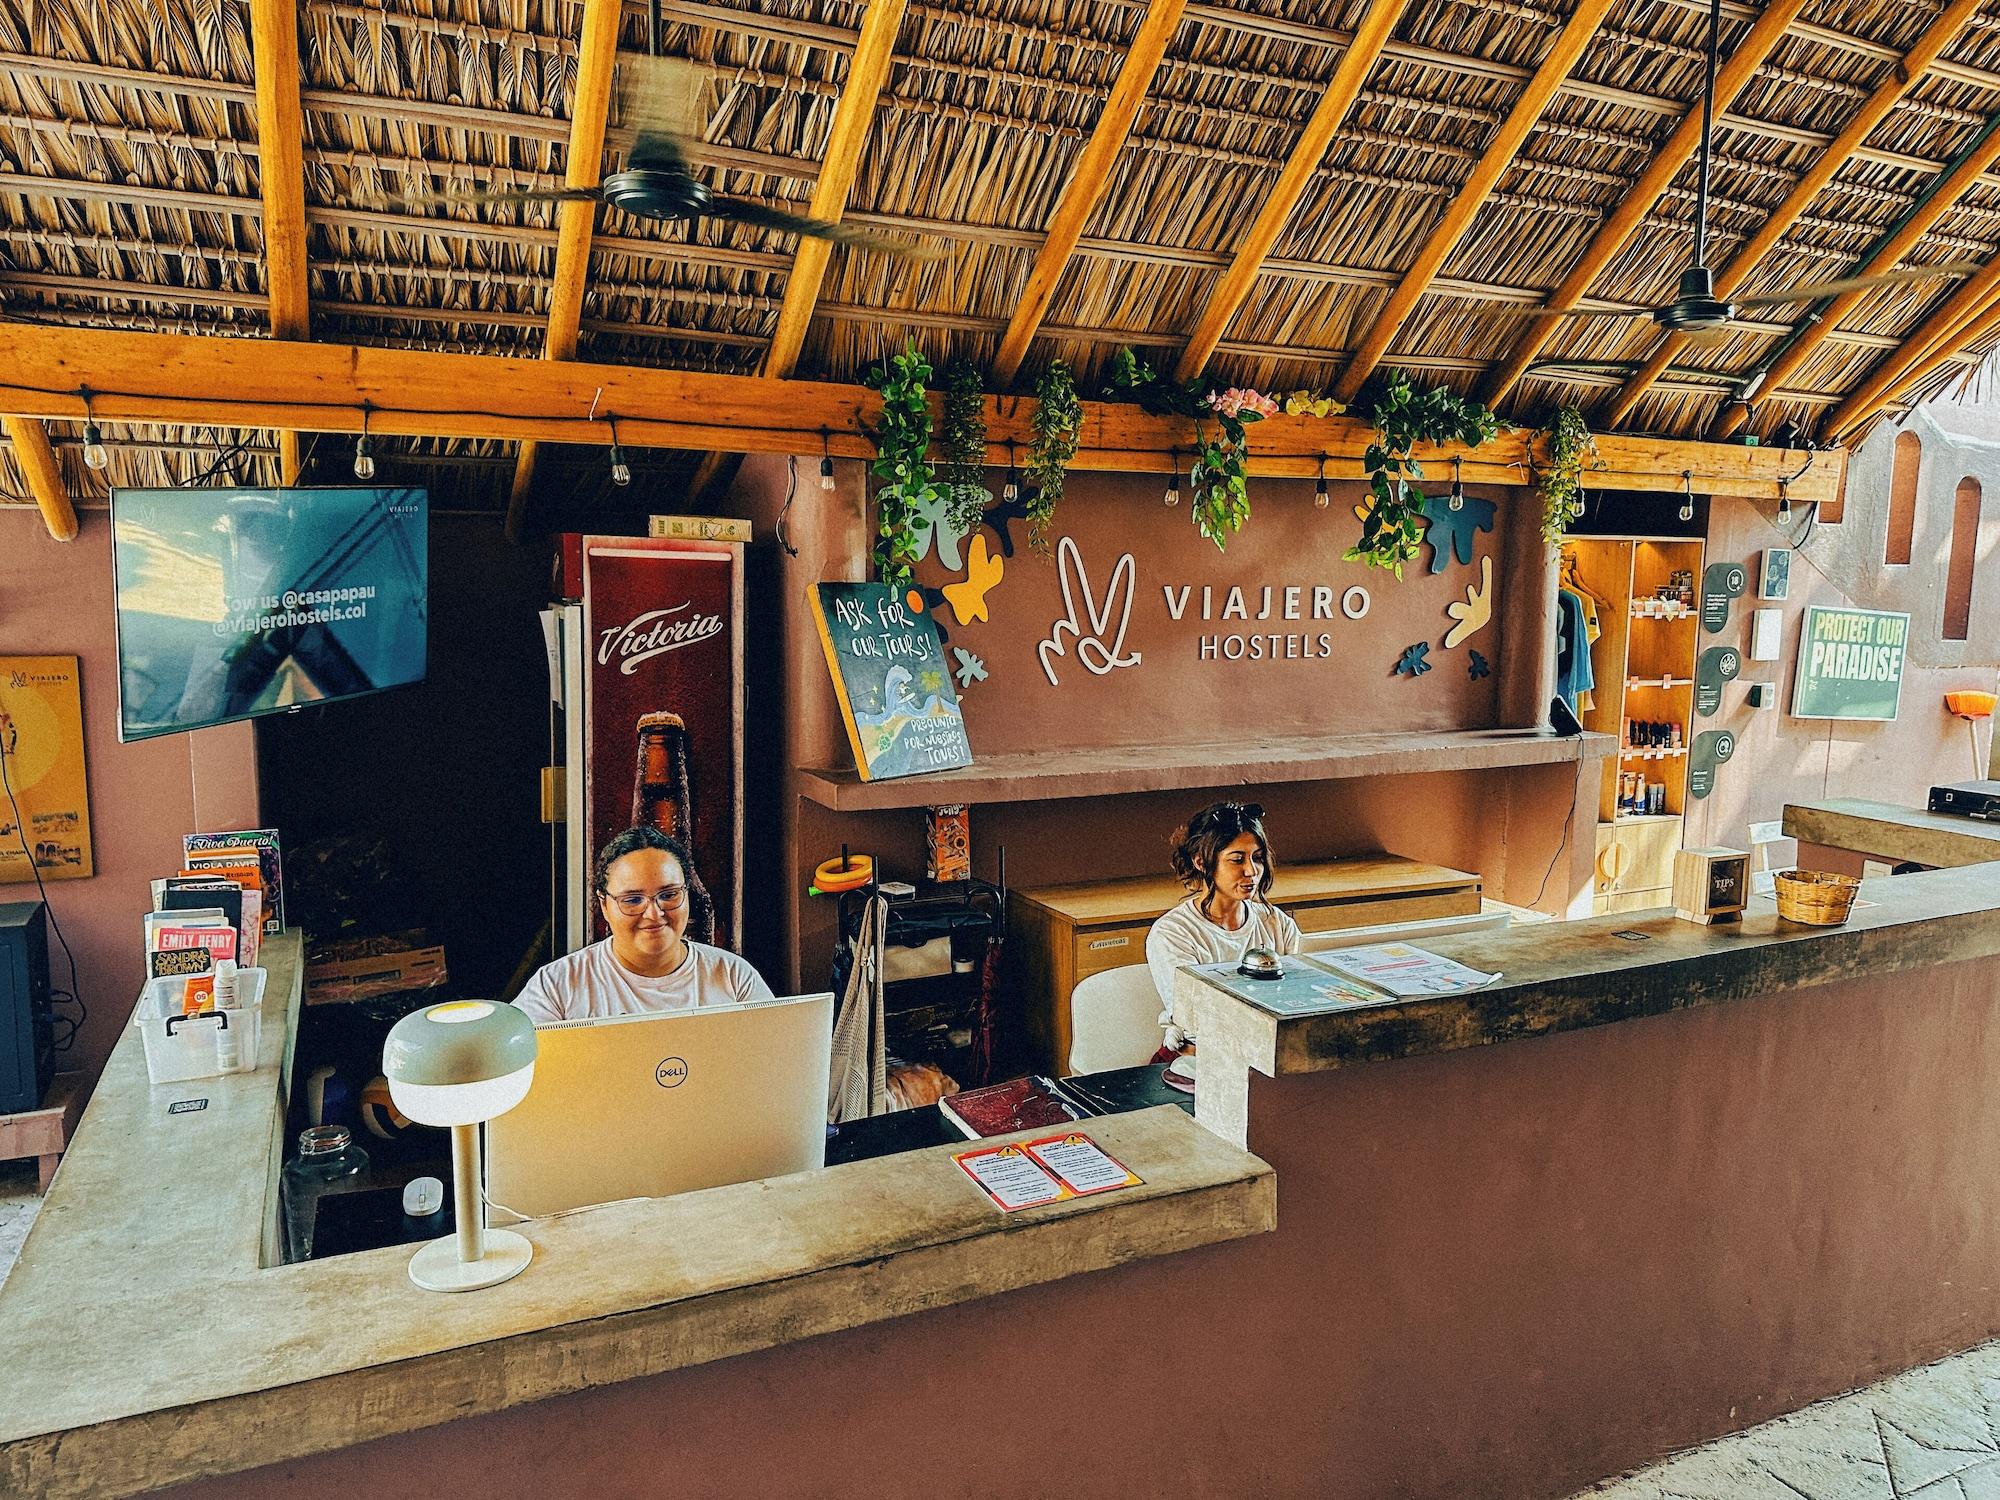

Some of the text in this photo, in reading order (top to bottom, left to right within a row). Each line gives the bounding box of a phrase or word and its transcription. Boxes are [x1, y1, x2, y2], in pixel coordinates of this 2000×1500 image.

[261, 595, 279, 609] us
[282, 586, 376, 610] @casapapau
[1163, 585, 1372, 621] VIAJERO
[213, 602, 366, 637] @viajerohostels.col
[835, 598, 873, 631] ASK
[597, 600, 723, 675] Victoria
[1813, 611, 1905, 646] PROTECT OUR
[851, 632, 934, 661] OUR TOURS!
[1200, 633, 1332, 660] HOSTELS
[1809, 641, 1902, 682] PARADISE
[904, 736, 925, 750] POR
[226, 835, 273, 849] Puerto!
[191, 862, 224, 870] VIOLA
[1714, 878, 1735, 889] TIPS
[162, 932, 232, 949] EMILY HENRY
[156, 949, 209, 966] SANDRA
[156, 960, 205, 976] BROWN
[660, 1067, 685, 1078] DELL
